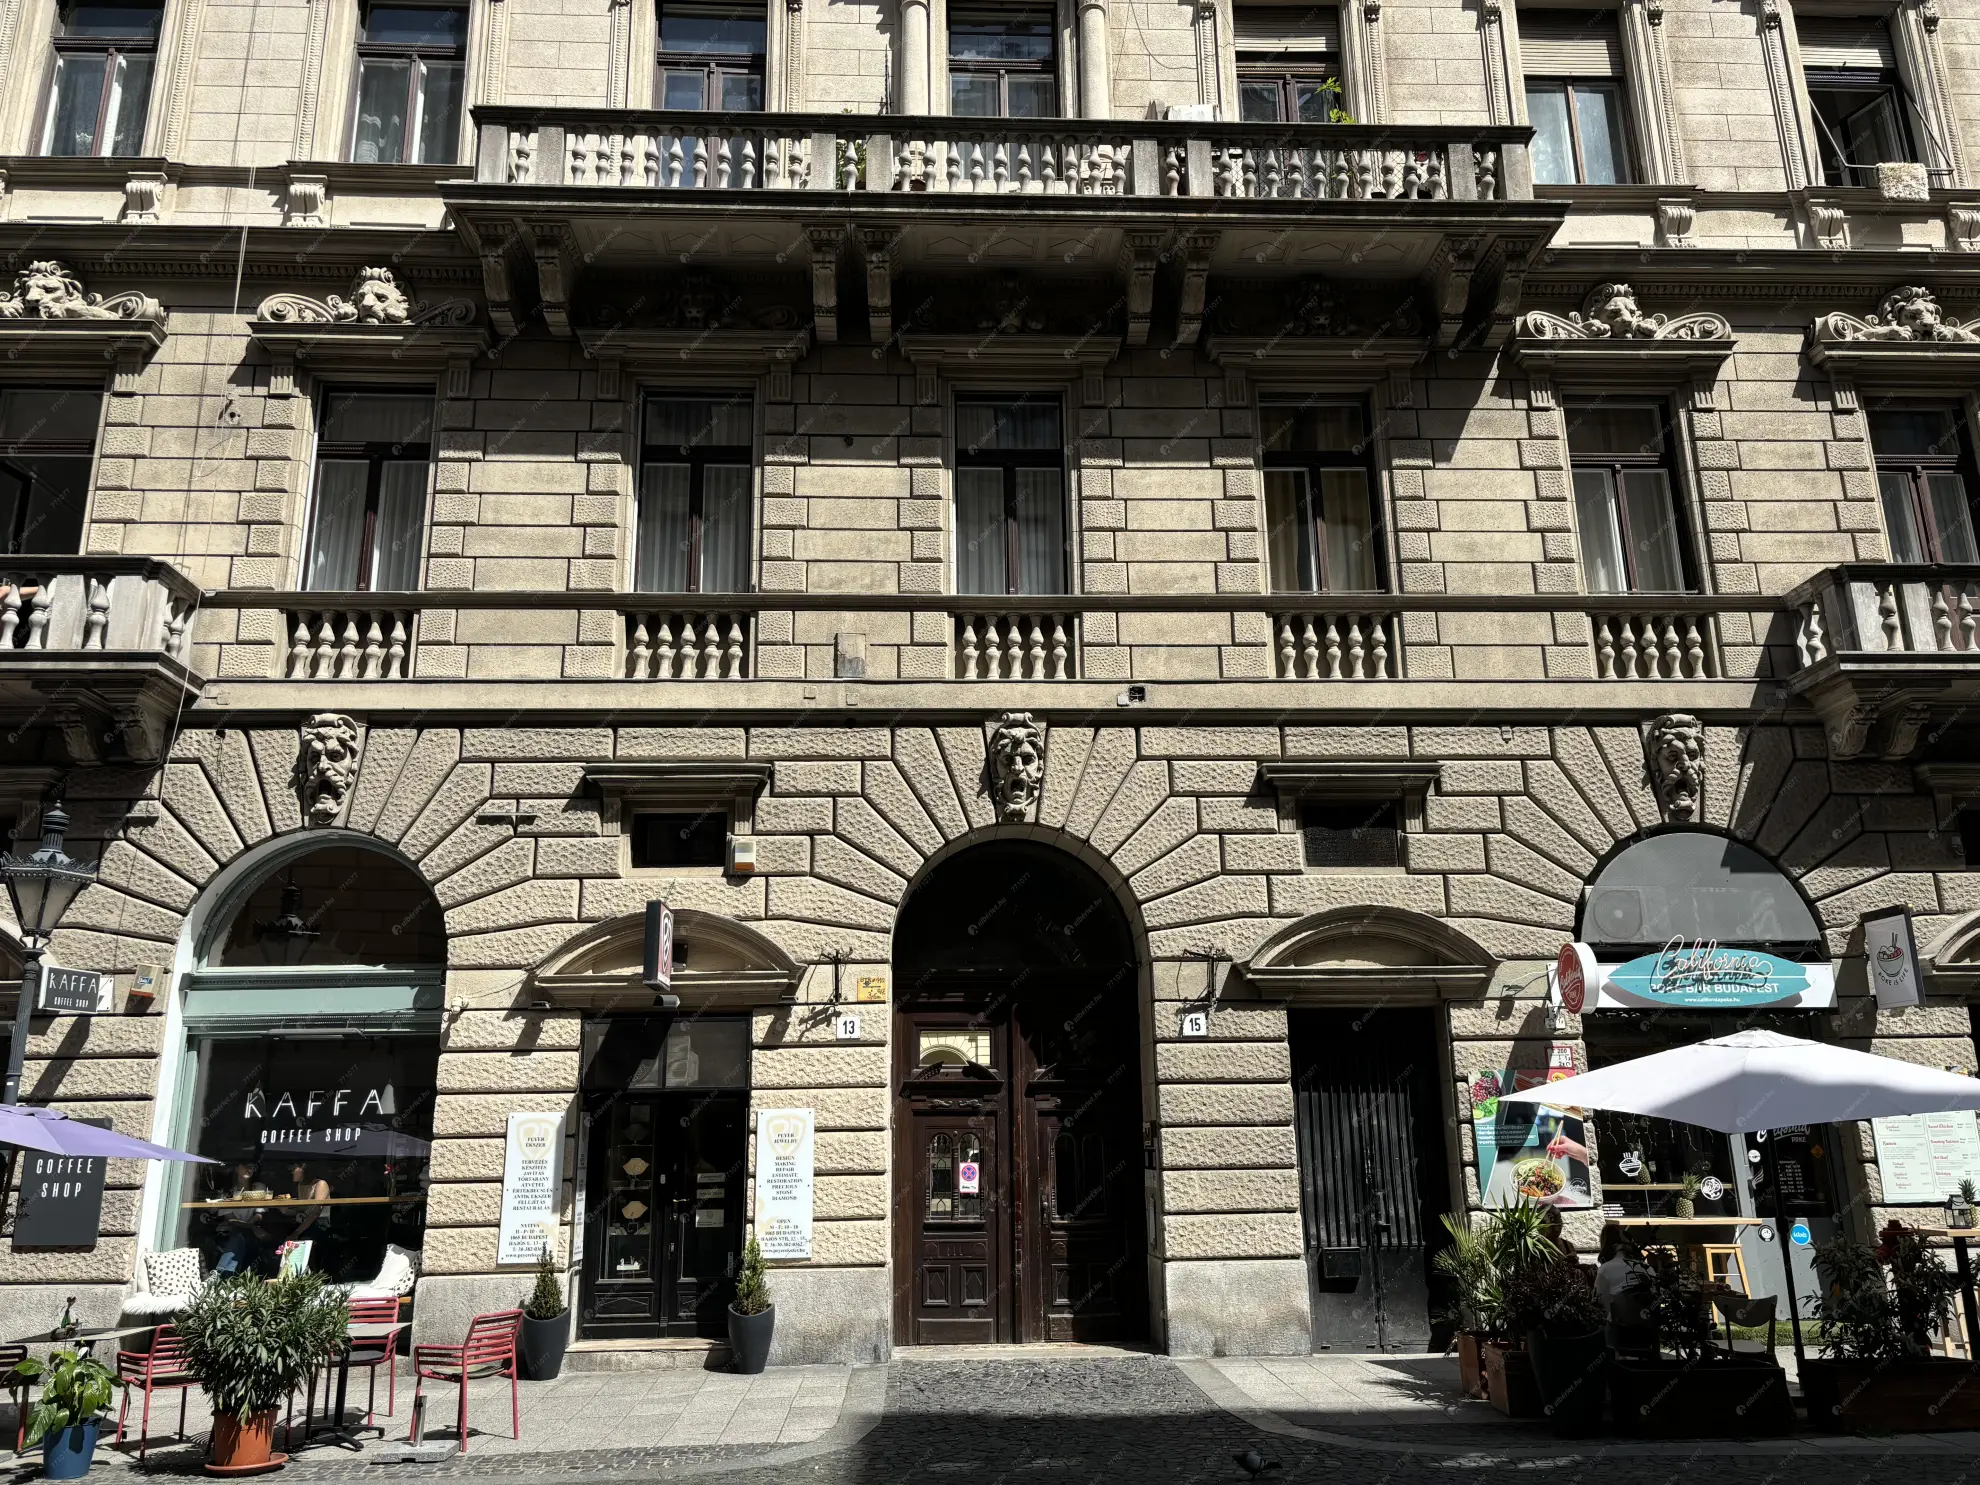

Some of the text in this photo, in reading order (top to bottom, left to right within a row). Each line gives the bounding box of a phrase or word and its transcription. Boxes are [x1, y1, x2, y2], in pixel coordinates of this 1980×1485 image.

[1656, 934, 1774, 979] California
[49, 972, 97, 994] KAFFA
[1877, 971, 1892, 986] POKE
[1899, 967, 1909, 982] LIFE
[1650, 983, 1779, 993] POKE BAR BUDAPEST
[54, 996, 89, 1008] COFFEE SHOP
[842, 1020, 855, 1035] 13
[1188, 1017, 1201, 1032] 15
[244, 1089, 385, 1119] KAFFA
[260, 1127, 362, 1144] COFFEE SHOP
[36, 1158, 94, 1174] COFFEE
[41, 1182, 82, 1198] SHOP
